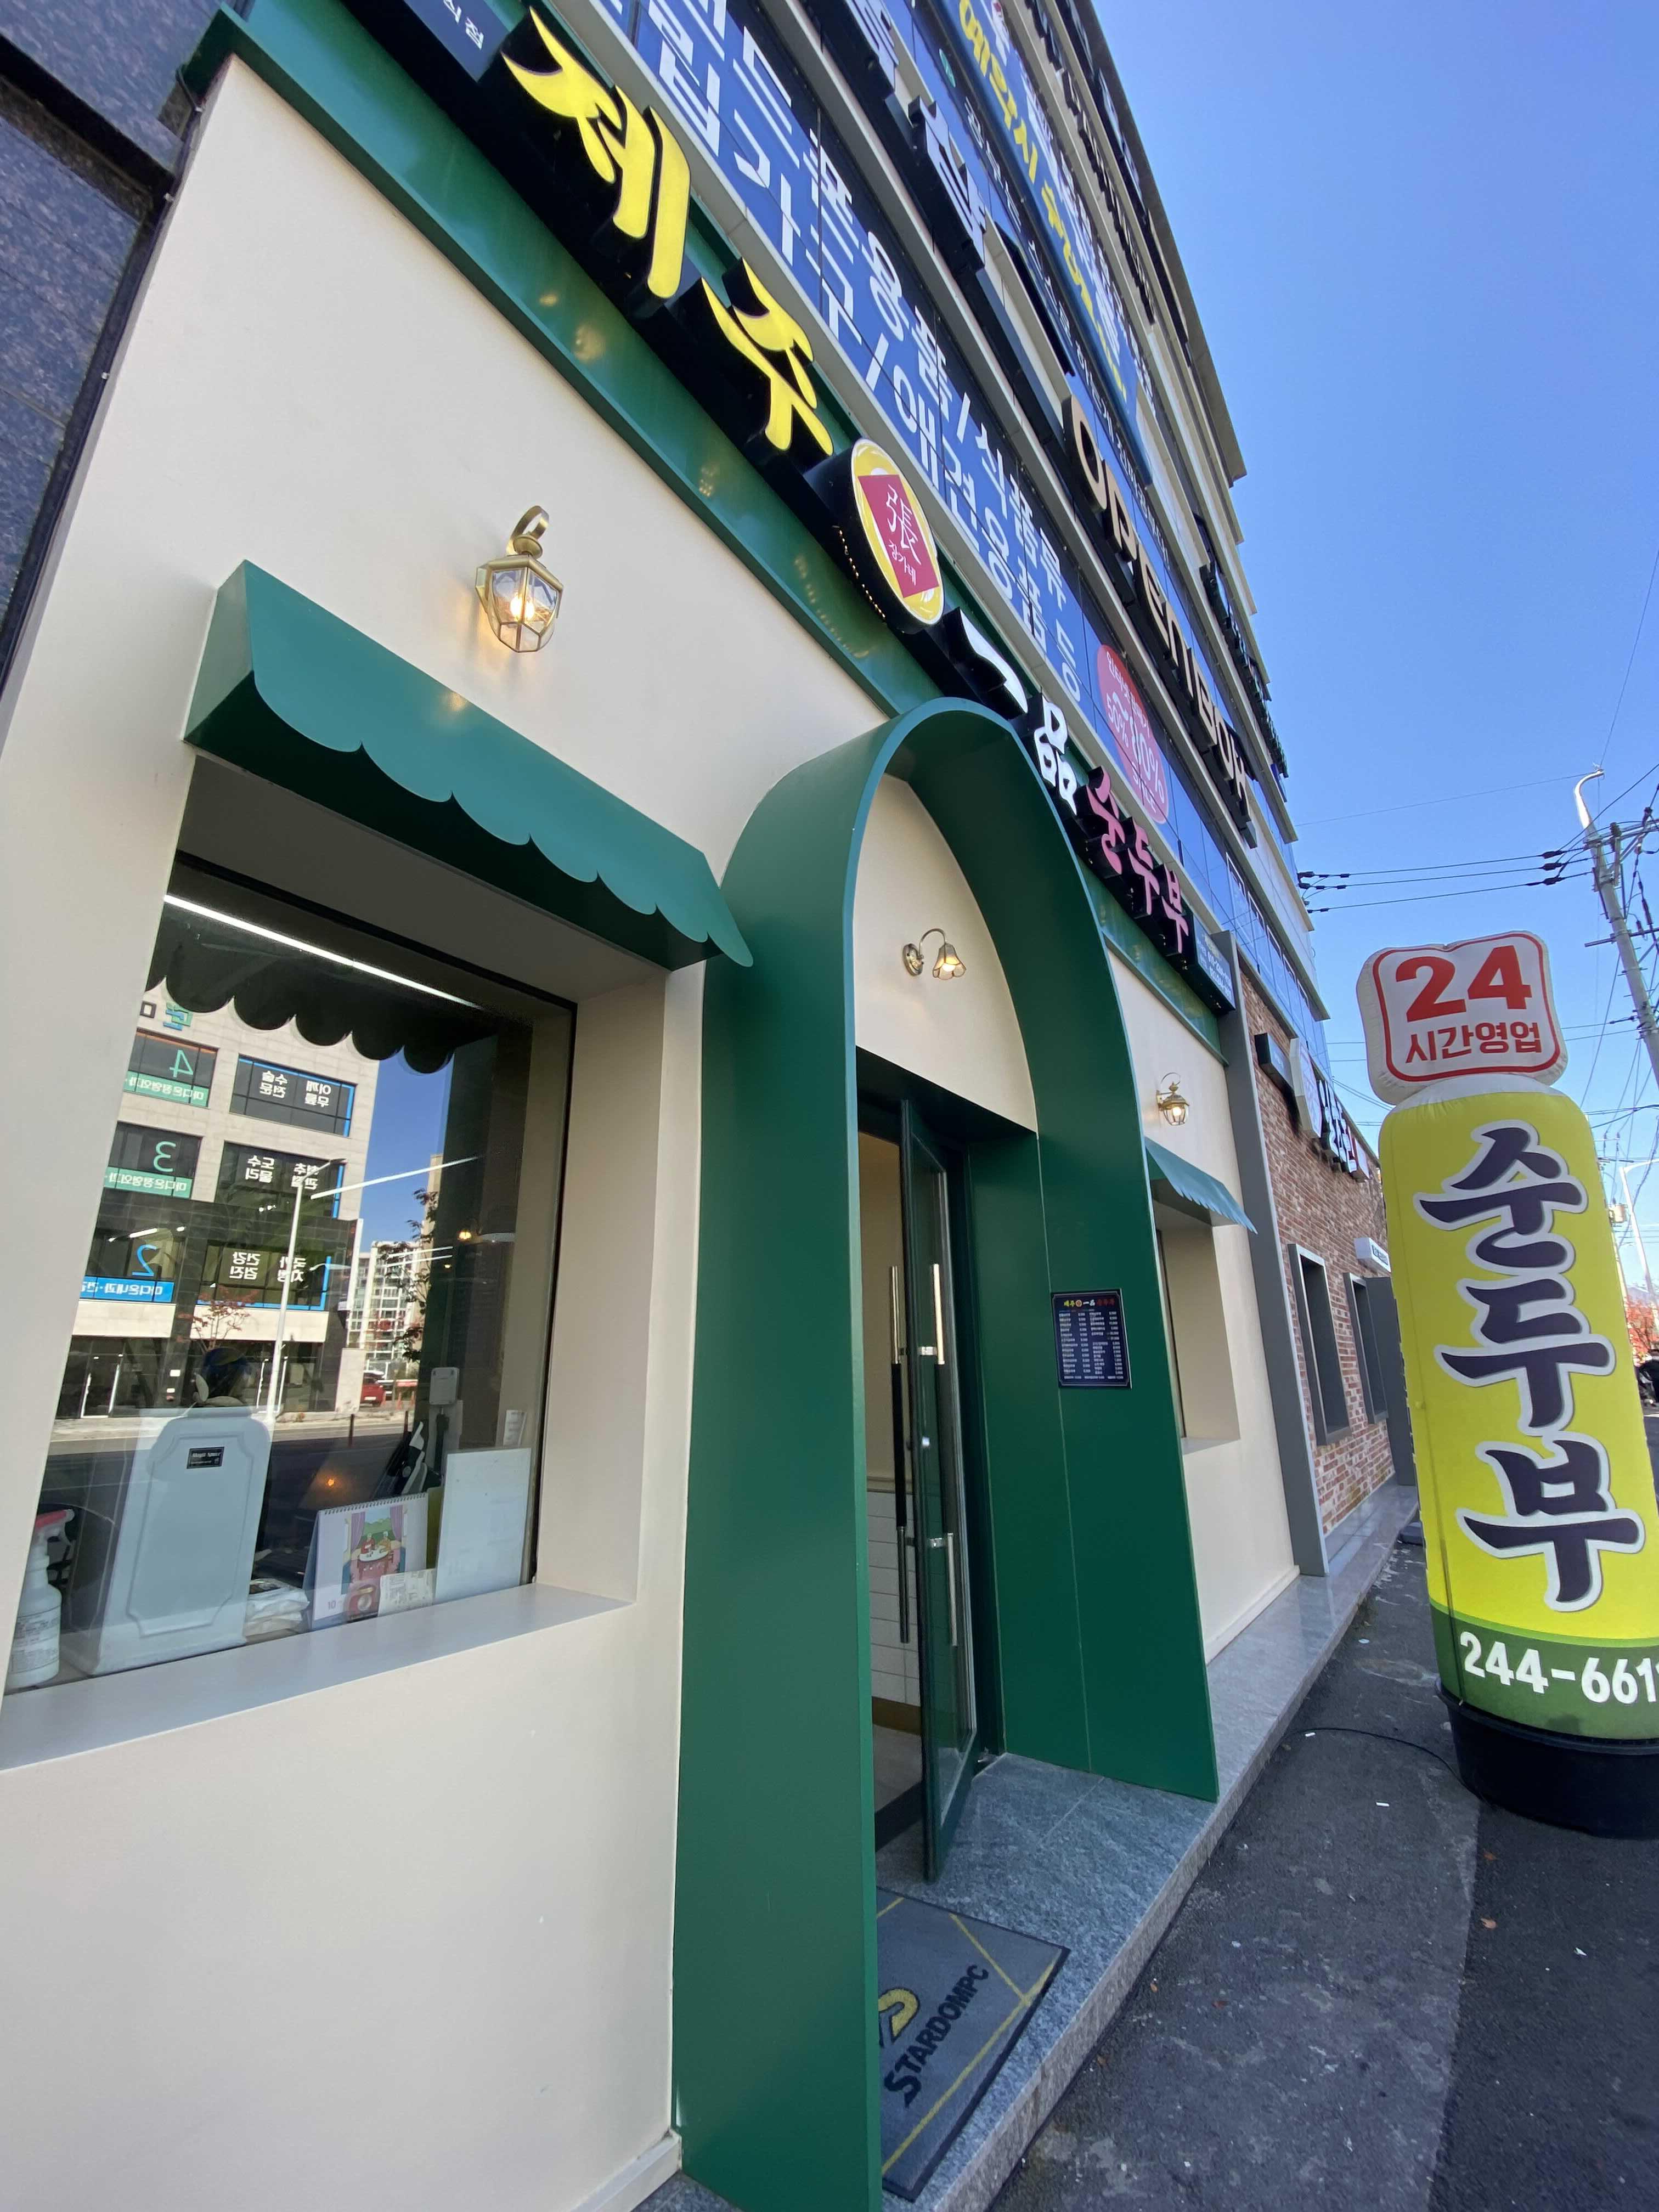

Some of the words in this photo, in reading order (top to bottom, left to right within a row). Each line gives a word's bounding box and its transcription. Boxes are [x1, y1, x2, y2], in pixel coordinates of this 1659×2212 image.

[501, 6, 835, 456] 제주
[964, 96, 1022, 233] 공부는
[1027, 239, 1073, 347] 스스로
[1087, 769, 1189, 953] 순두부
[1395, 945, 1532, 1023] 24
[1405, 1020, 1542, 1064] 시간영업
[1418, 1126, 1640, 1603] 순두부
[1460, 1632, 1659, 1705] 244-661
[884, 1964, 989, 2108] STARDOMPC
